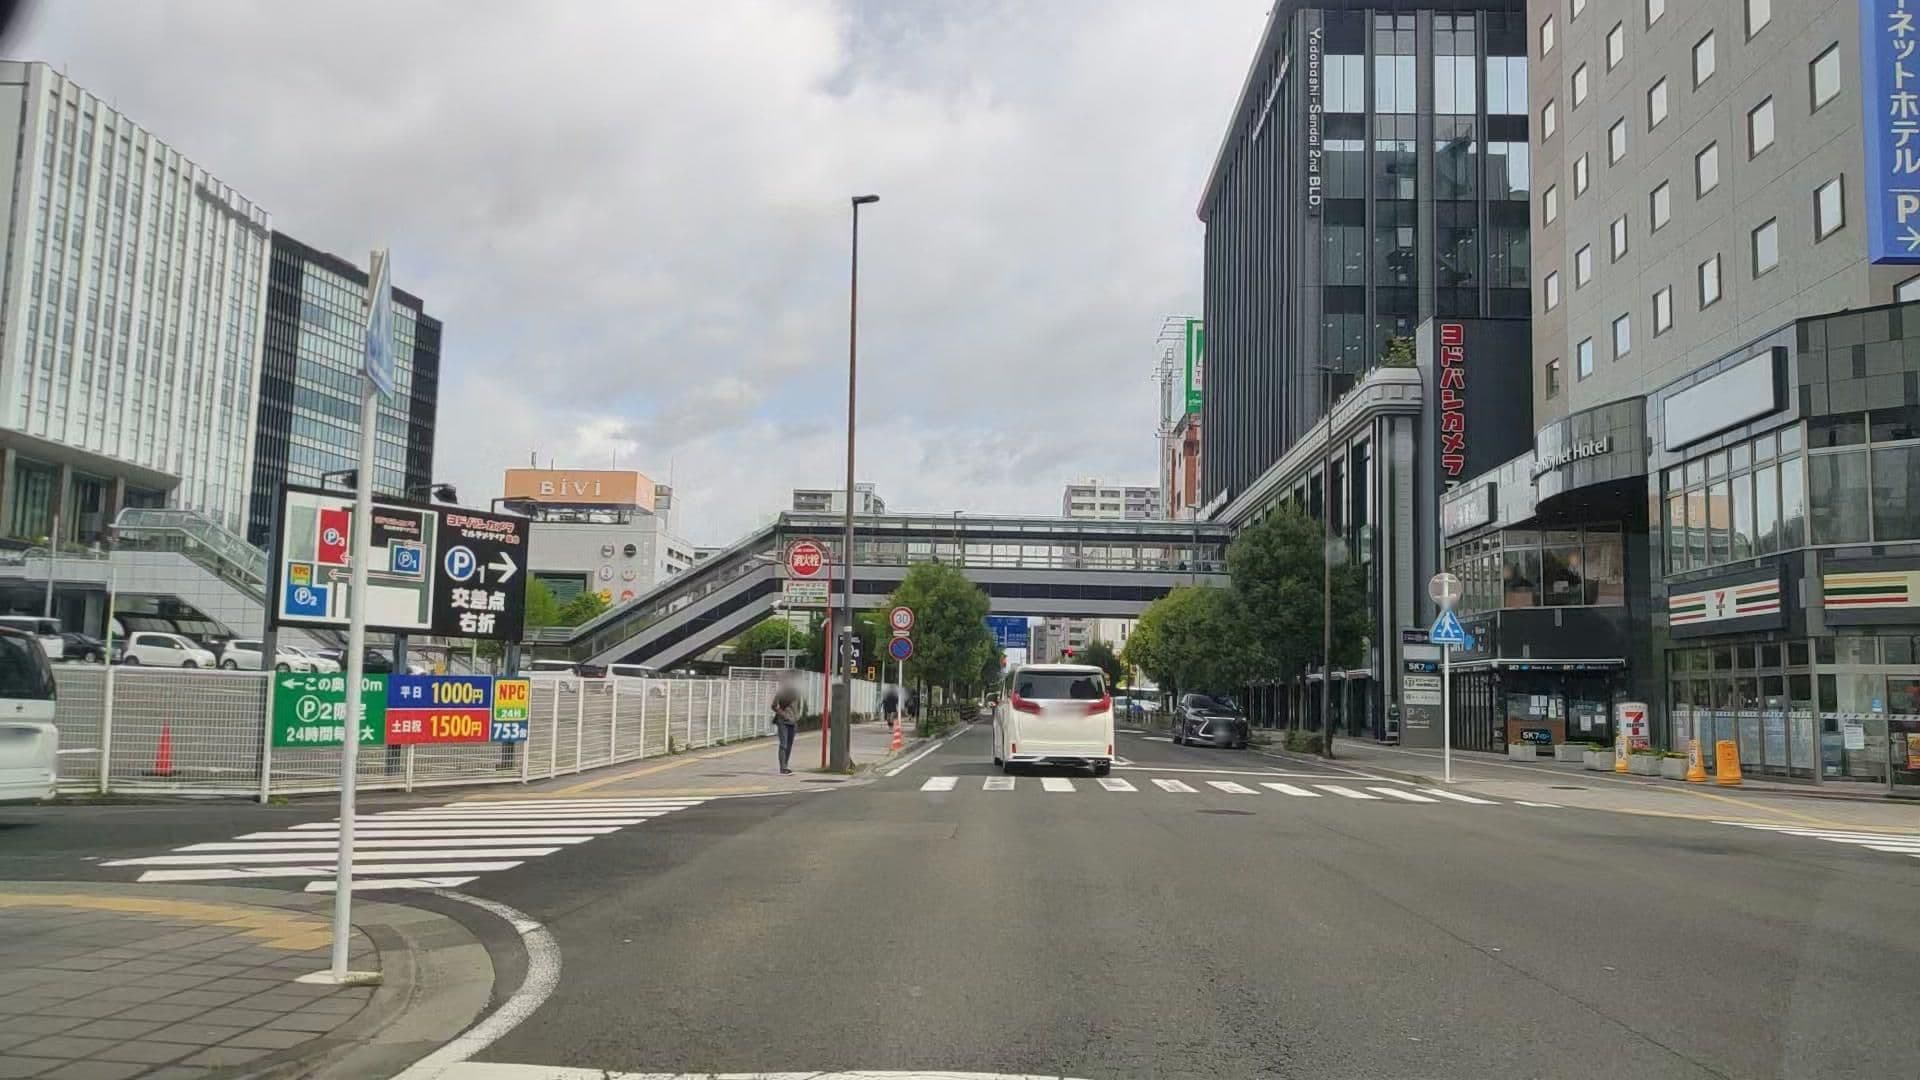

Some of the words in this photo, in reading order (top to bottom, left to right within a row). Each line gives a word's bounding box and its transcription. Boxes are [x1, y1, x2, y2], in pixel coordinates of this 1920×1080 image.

[1309, 150, 1321, 172] 2nd
[1309, 176, 1321, 209] BLD.
[1897, 195, 1919, 224] P
[1441, 324, 1465, 476] ヨドバシカメラ
[1573, 433, 1607, 460] Hotel
[451, 587, 506, 612] 交差点
[459, 611, 495, 634] 右折
[895, 613, 909, 625] 30
[400, 686, 422, 699] 平日
[431, 682, 484, 704] 1000円
[499, 684, 525, 700] NPC
[391, 720, 422, 733] 土日祝
[430, 715, 482, 737] 1500円
